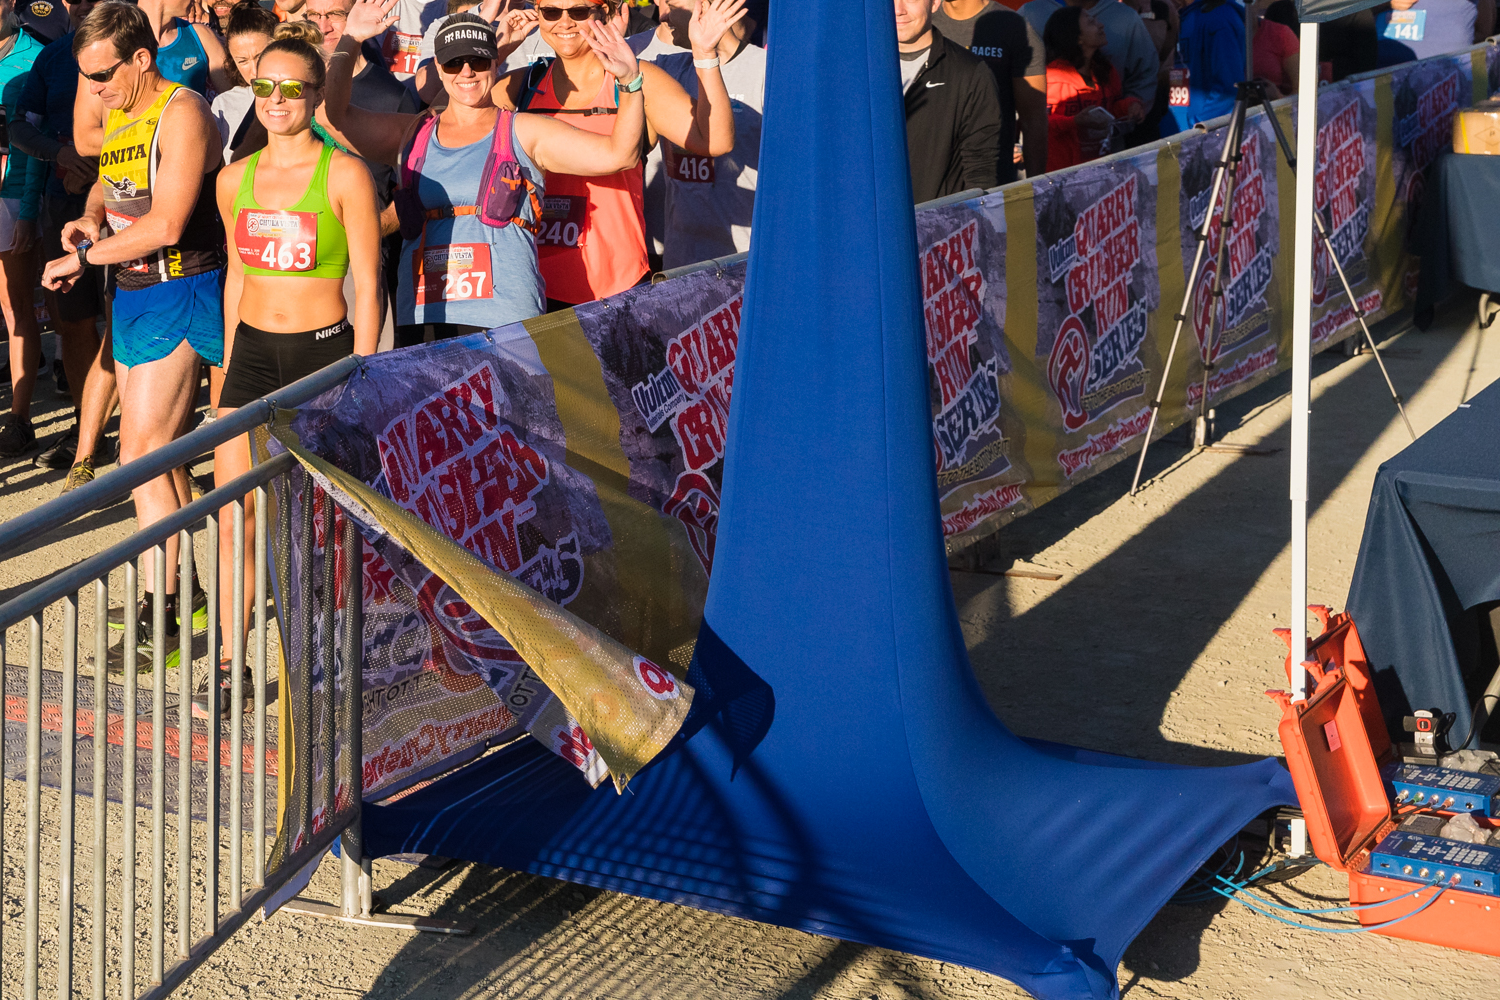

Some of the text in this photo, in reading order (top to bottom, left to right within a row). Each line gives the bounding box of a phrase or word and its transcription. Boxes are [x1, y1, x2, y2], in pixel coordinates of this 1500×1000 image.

[455, 29, 488, 43] RAGNAR
[1393, 22, 1418, 40] 141
[1169, 87, 1189, 105] 399
[101, 144, 146, 167] ONITA
[678, 156, 710, 181] 416
[1076, 178, 1137, 256] QUARRY
[536, 220, 579, 247] 240
[261, 241, 312, 270] 463
[920, 222, 976, 299] ARRY
[1068, 220, 1140, 314] CRUSHER
[440, 271, 487, 300] 267
[1096, 278, 1128, 338] RUN
[315, 324, 341, 341] NIKE
[1089, 299, 1148, 386] SERIES
[935, 336, 972, 406] RUN
[633, 366, 681, 418] Vulcan
[937, 360, 1000, 460] SERIES
